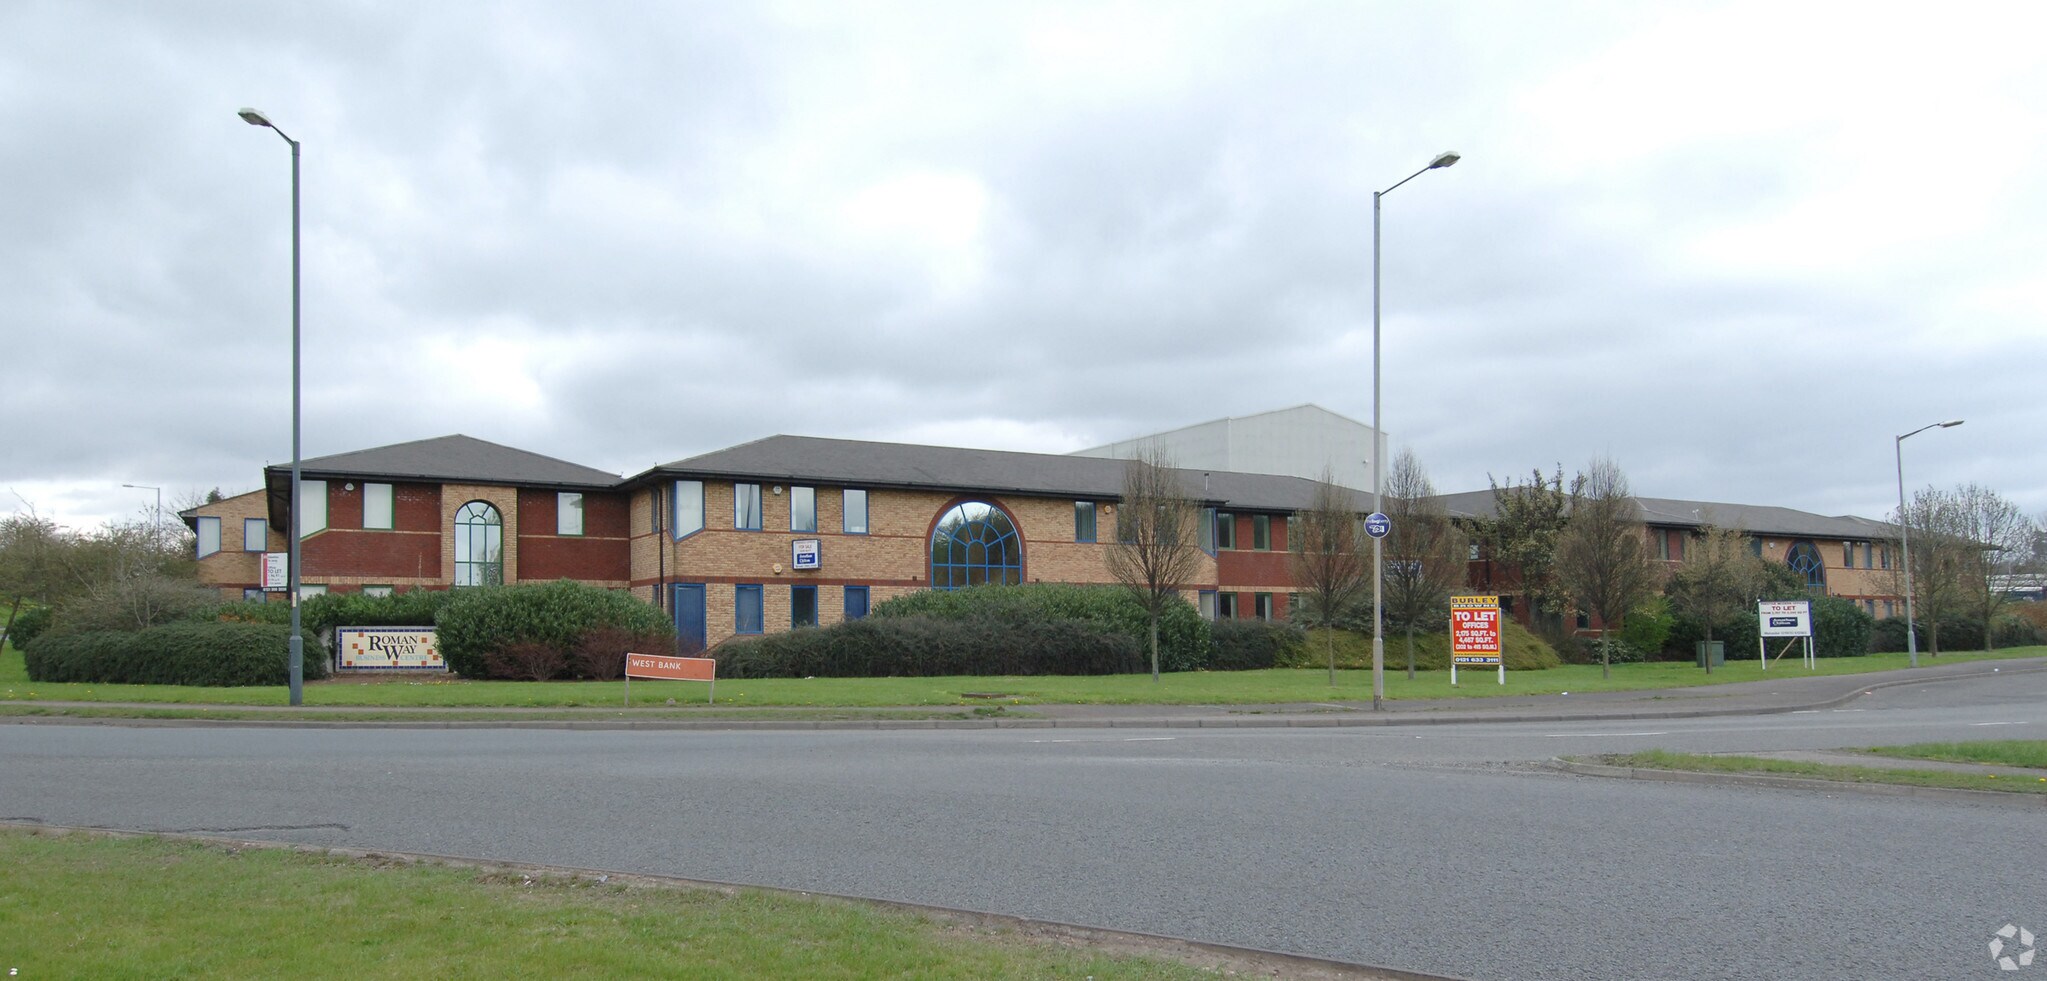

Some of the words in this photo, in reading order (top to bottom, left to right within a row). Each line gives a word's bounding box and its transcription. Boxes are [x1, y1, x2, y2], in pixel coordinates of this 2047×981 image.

[1454, 612, 1471, 621] TO
[1474, 611, 1496, 621] LET
[368, 636, 418, 651] ROMAN
[383, 645, 417, 660] WAY
[632, 659, 655, 668] WEST
[658, 661, 681, 670] BANK
